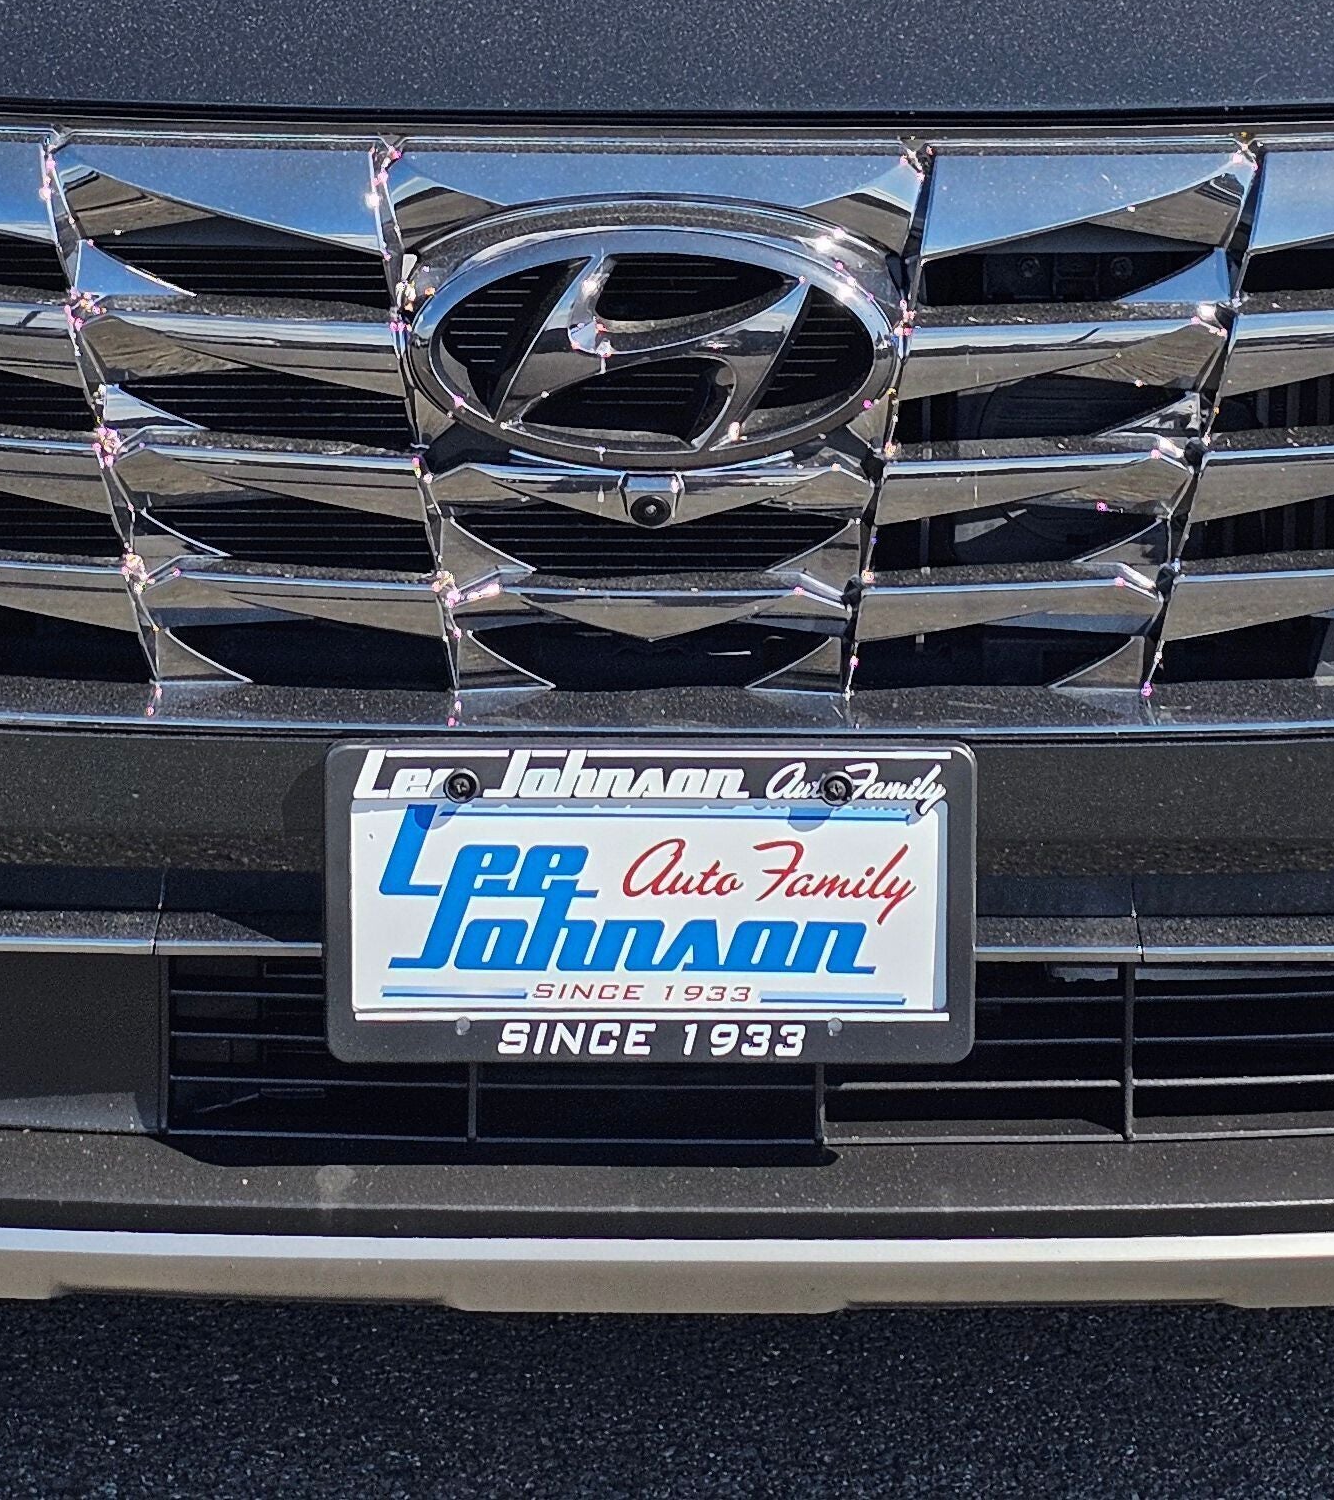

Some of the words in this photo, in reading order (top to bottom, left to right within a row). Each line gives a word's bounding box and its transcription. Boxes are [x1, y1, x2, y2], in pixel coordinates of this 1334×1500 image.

[482, 749, 750, 799] Johnson
[378, 803, 599, 896] Lee
[622, 838, 745, 898] Auto
[753, 840, 917, 925] Family
[388, 880, 877, 975] Johnson
[532, 983, 645, 1002] SINCE
[663, 985, 753, 1003] 1933
[497, 1021, 657, 1057] SINCE
[681, 1023, 807, 1058] 1933
